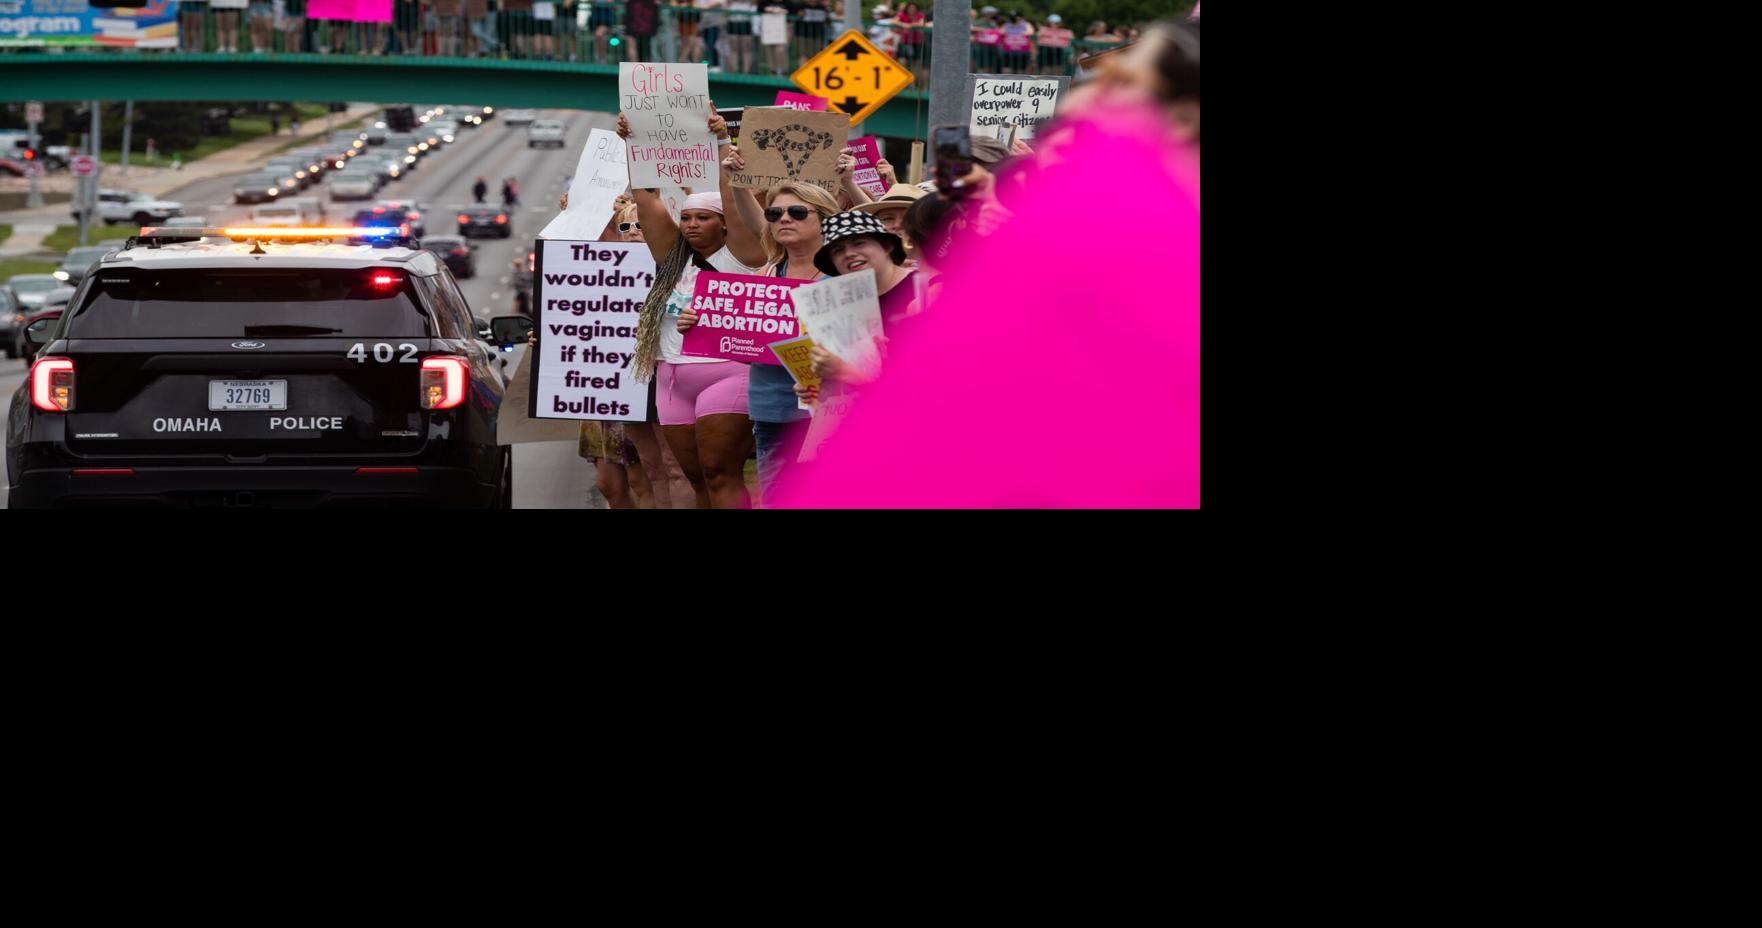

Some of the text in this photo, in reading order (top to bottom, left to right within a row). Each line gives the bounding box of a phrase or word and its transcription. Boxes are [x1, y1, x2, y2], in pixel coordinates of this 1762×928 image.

[632, 64, 683, 96] Girls
[977, 81, 1057, 100] I could easily
[974, 98, 1024, 111] overpower
[977, 114, 1008, 126] senior
[631, 142, 715, 161] Fundamental
[657, 162, 707, 184] Rights!
[817, 179, 835, 192] ME
[571, 244, 629, 266] They
[707, 280, 791, 300] PROTECT
[547, 295, 645, 316] regulate
[694, 296, 740, 315] SAFE,
[744, 300, 797, 318] LEGA
[697, 313, 795, 335] ABORTION
[731, 337, 754, 345] Planned
[731, 343, 764, 353] Parenthood
[347, 343, 419, 363] 402
[561, 345, 635, 369] if they
[565, 370, 620, 390] fired
[226, 388, 270, 404] 32769
[553, 395, 630, 415] bullets
[153, 417, 343, 432] OMAHA POLICE
